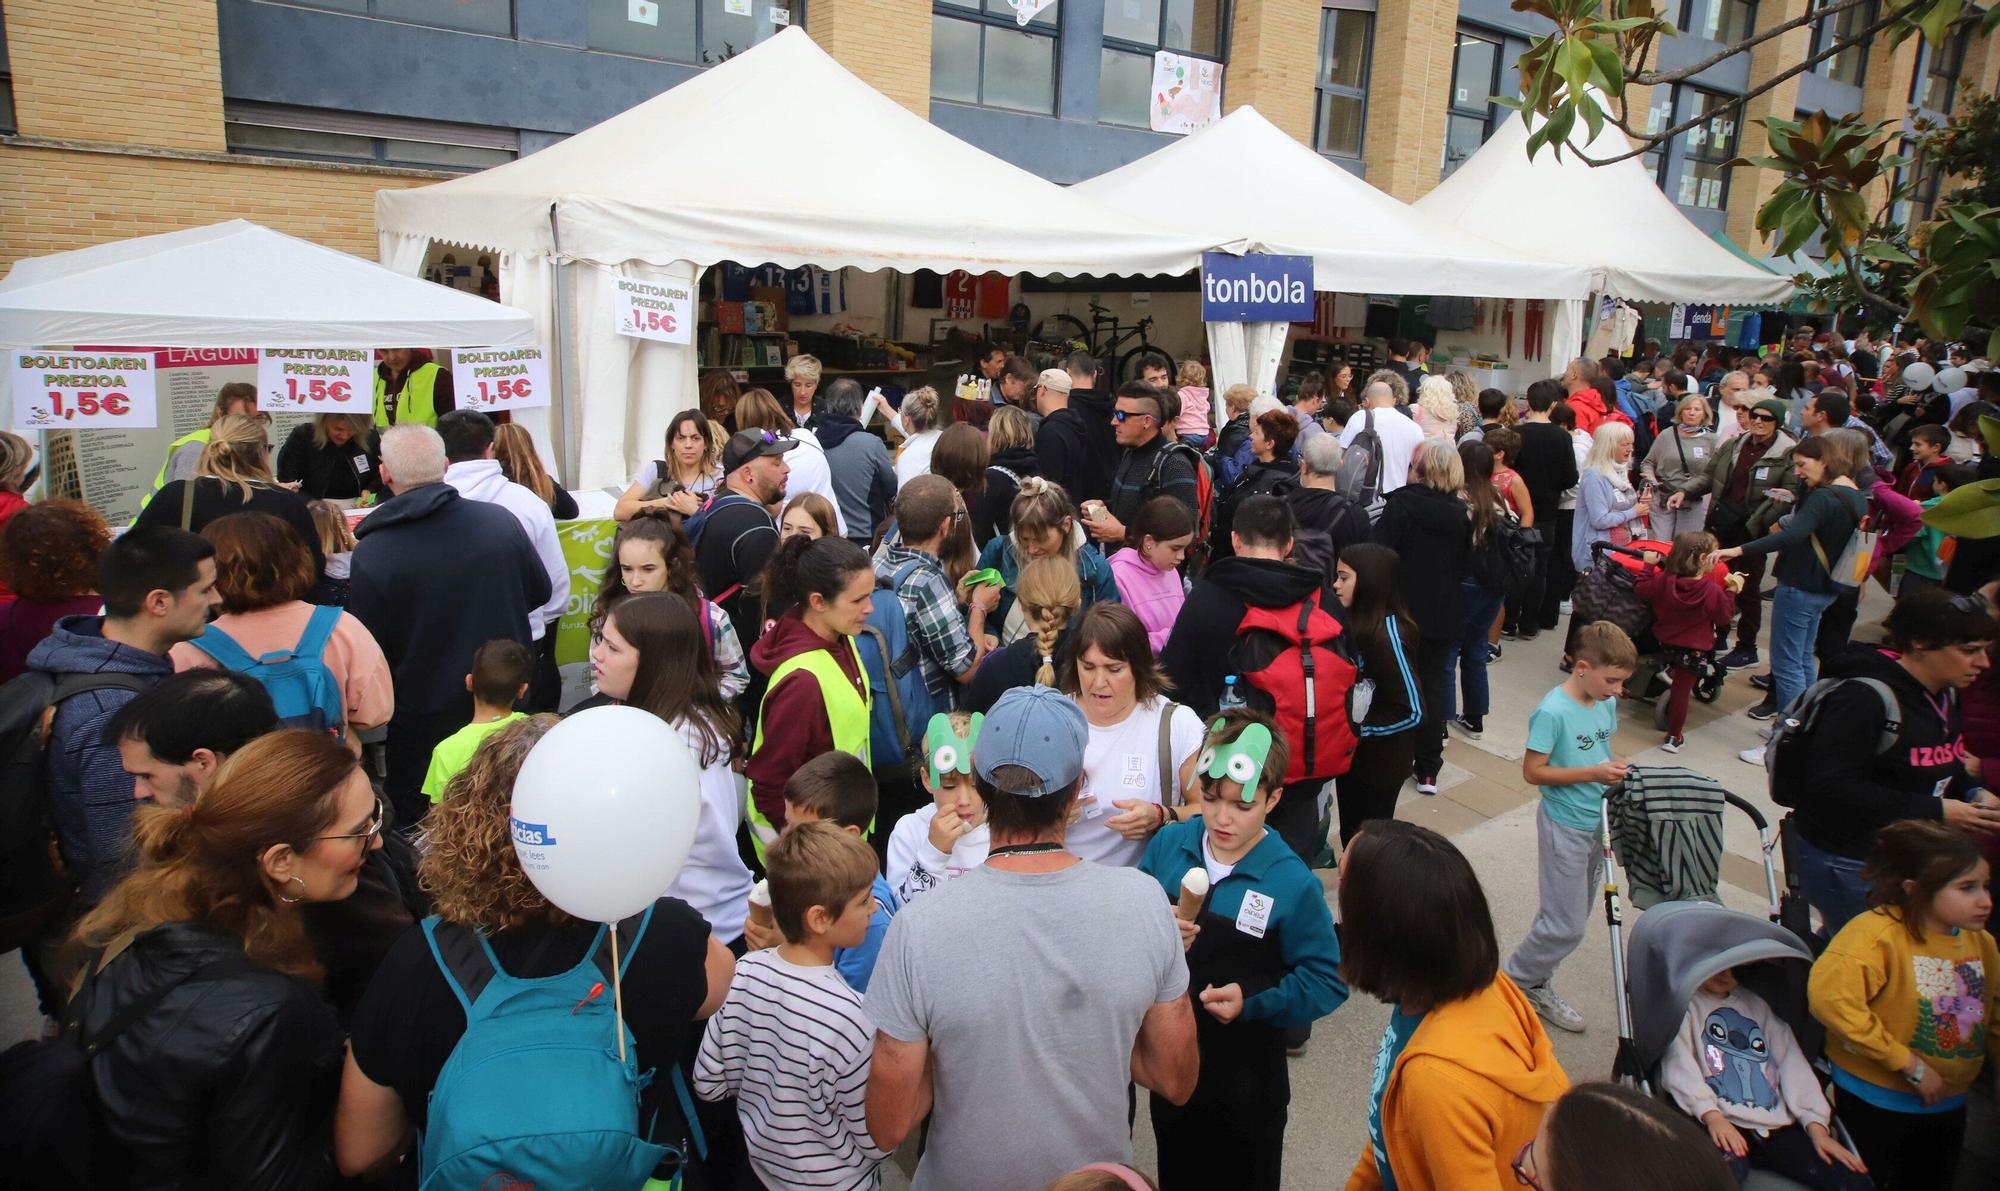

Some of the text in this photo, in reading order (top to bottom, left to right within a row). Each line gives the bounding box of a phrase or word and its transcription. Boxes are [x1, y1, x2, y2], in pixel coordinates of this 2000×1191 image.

[618, 280, 689, 300] BOLETOAREN
[1205, 272, 1305, 304] tonbola
[630, 296, 676, 312] PREZIOA
[633, 309, 677, 333] 1,5€
[1692, 311, 1712, 324] denda
[19, 355, 147, 370] BOLETOAREN
[265, 348, 368, 362] BOLETOAREN
[457, 349, 542, 365] BOLETOAREN
[283, 363, 350, 377] PREZIOA
[474, 364, 529, 378] PREZIOA
[44, 374, 128, 388] PREZIOA
[286, 378, 352, 405] 1,5€
[477, 378, 532, 405] 1,5€
[49, 391, 130, 420] 1,5€
